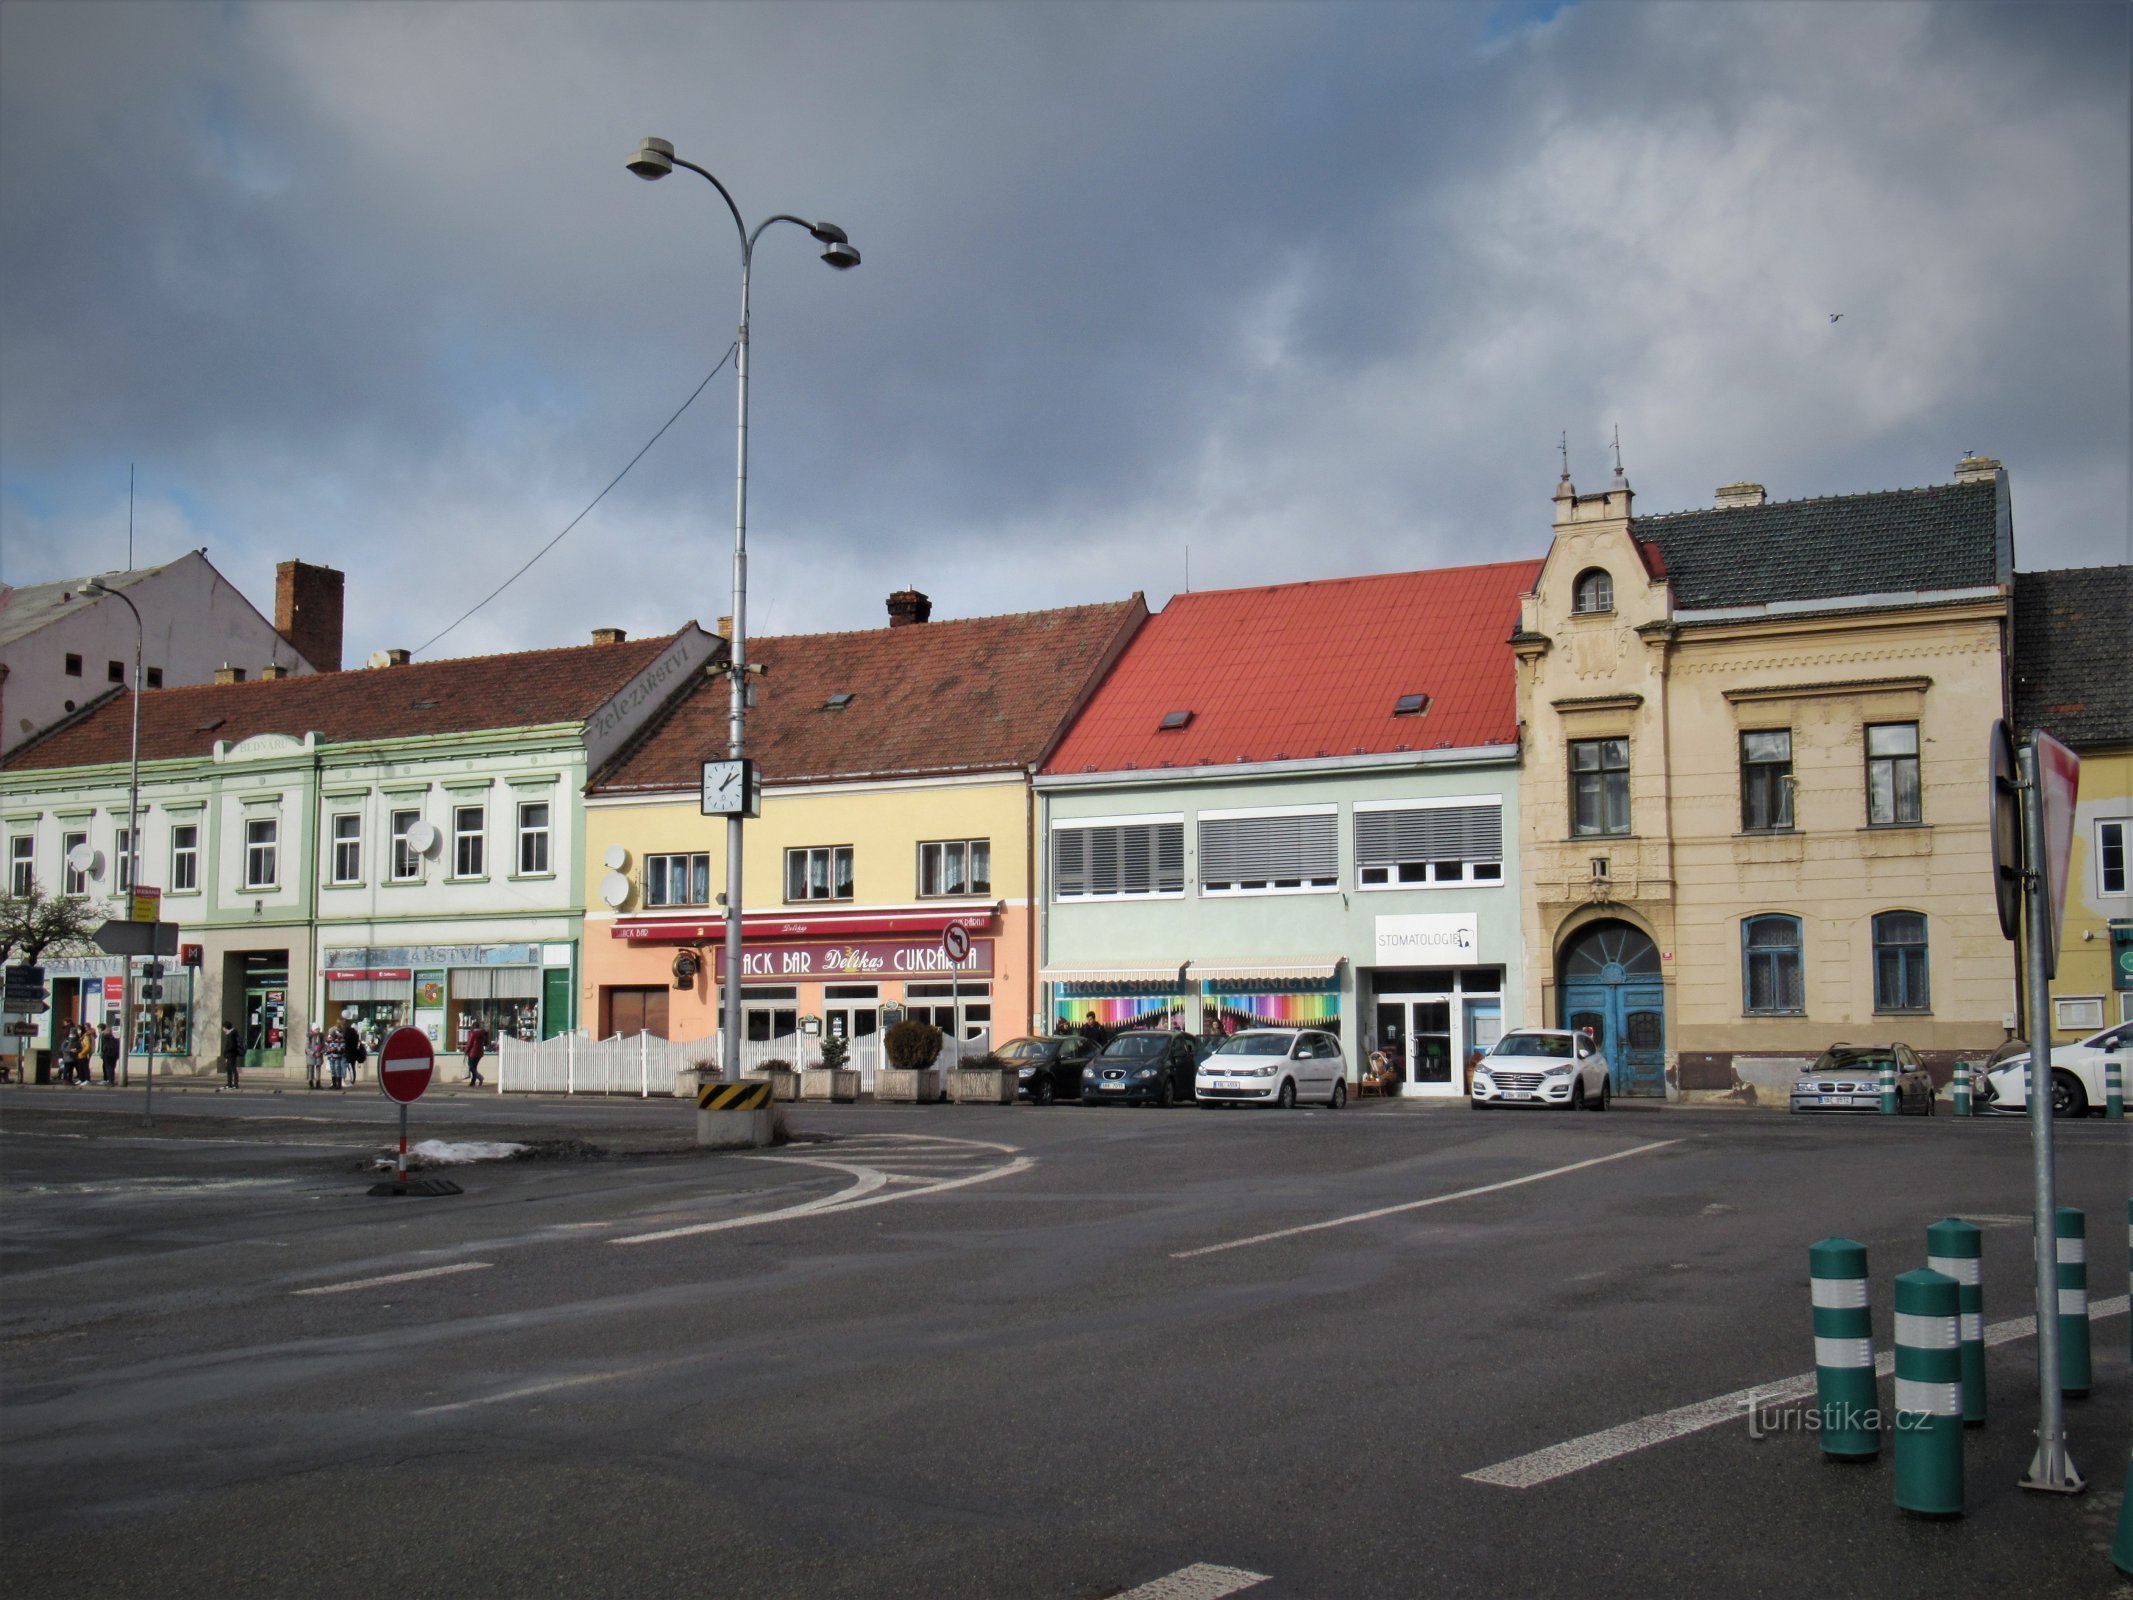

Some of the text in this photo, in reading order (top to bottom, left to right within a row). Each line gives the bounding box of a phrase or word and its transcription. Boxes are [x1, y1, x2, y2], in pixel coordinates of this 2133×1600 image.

[1378, 932, 1459, 947] STOMATOLOGIE
[742, 951, 811, 975] ACK BAR
[822, 949, 884, 970] Delikas
[1128, 980, 1179, 993] SPORT
